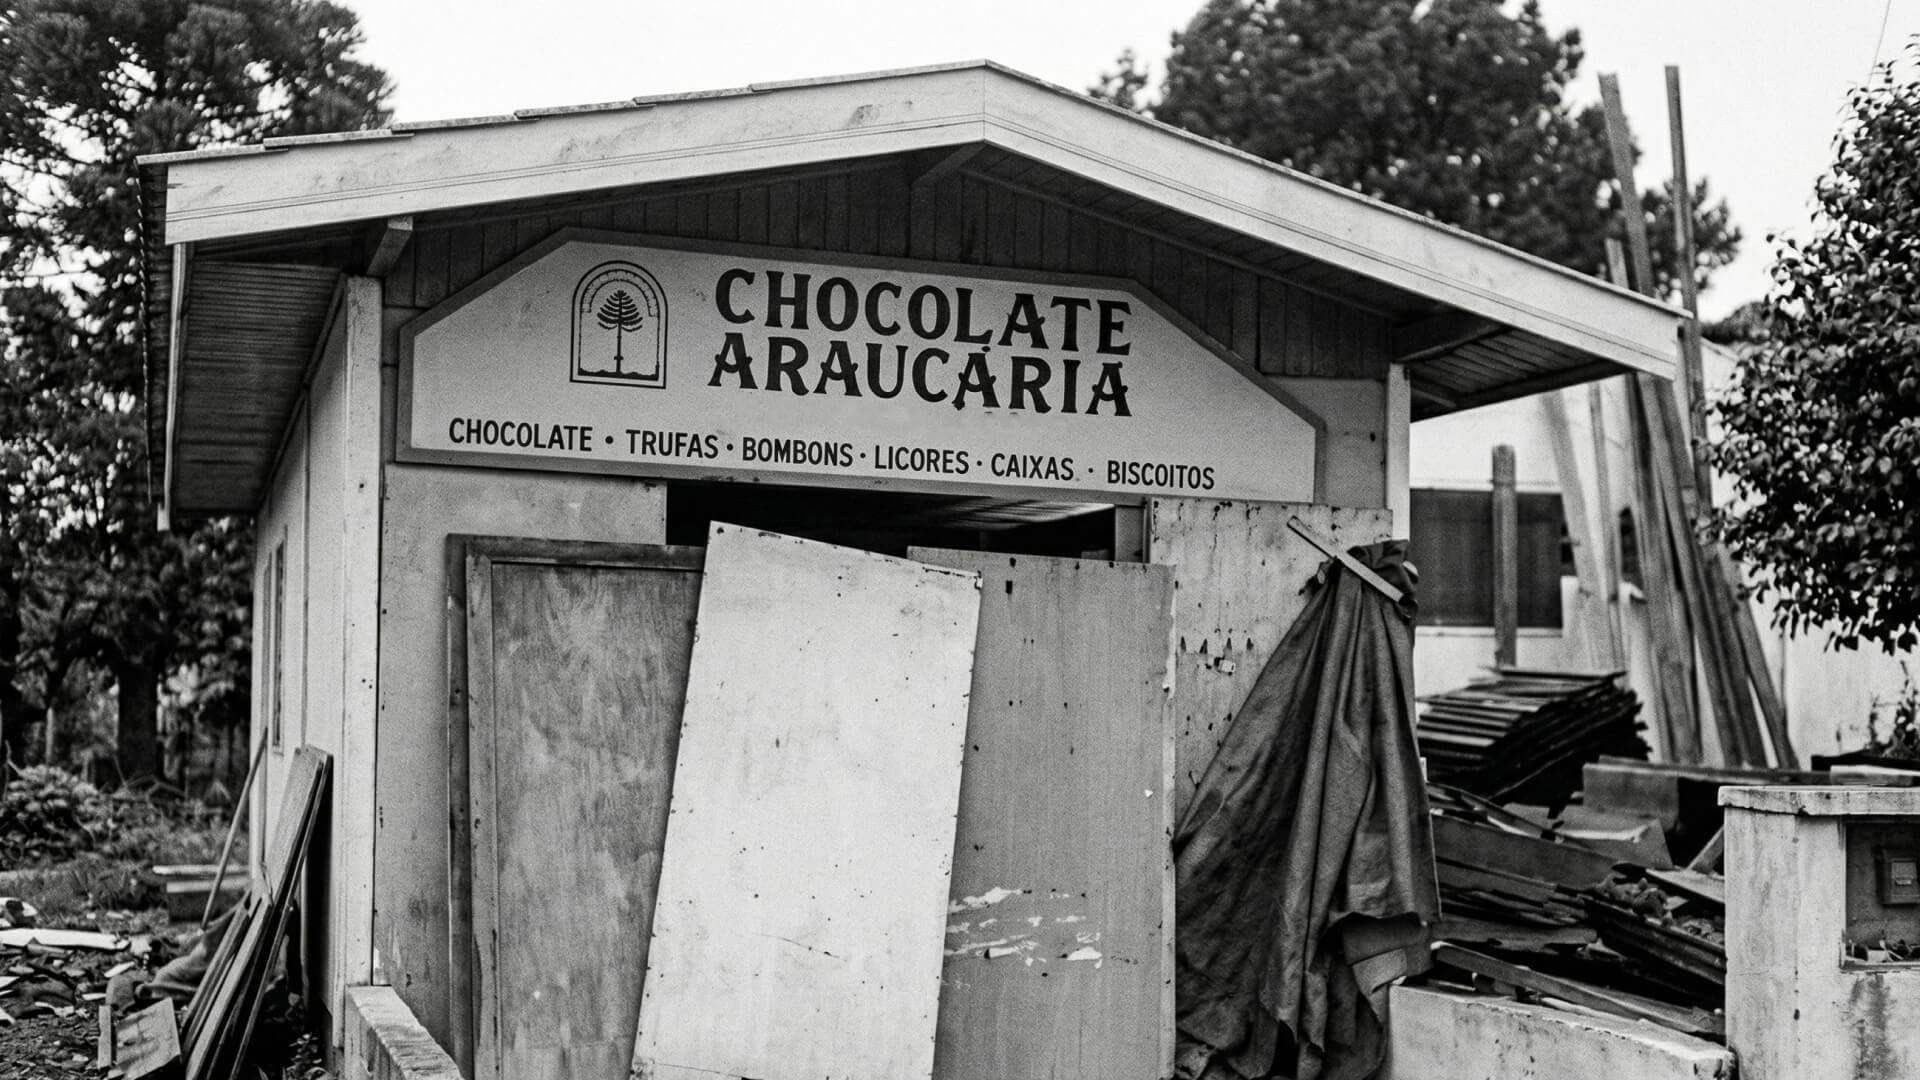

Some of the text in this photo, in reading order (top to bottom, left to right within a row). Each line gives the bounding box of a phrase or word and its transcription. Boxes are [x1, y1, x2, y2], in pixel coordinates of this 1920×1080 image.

[715, 268, 1131, 356] CHOCOLATE
[449, 418, 1215, 490] CHOCOLATE TRUFAS BOMBONS LICORES CAIXAS BISCOITOS
